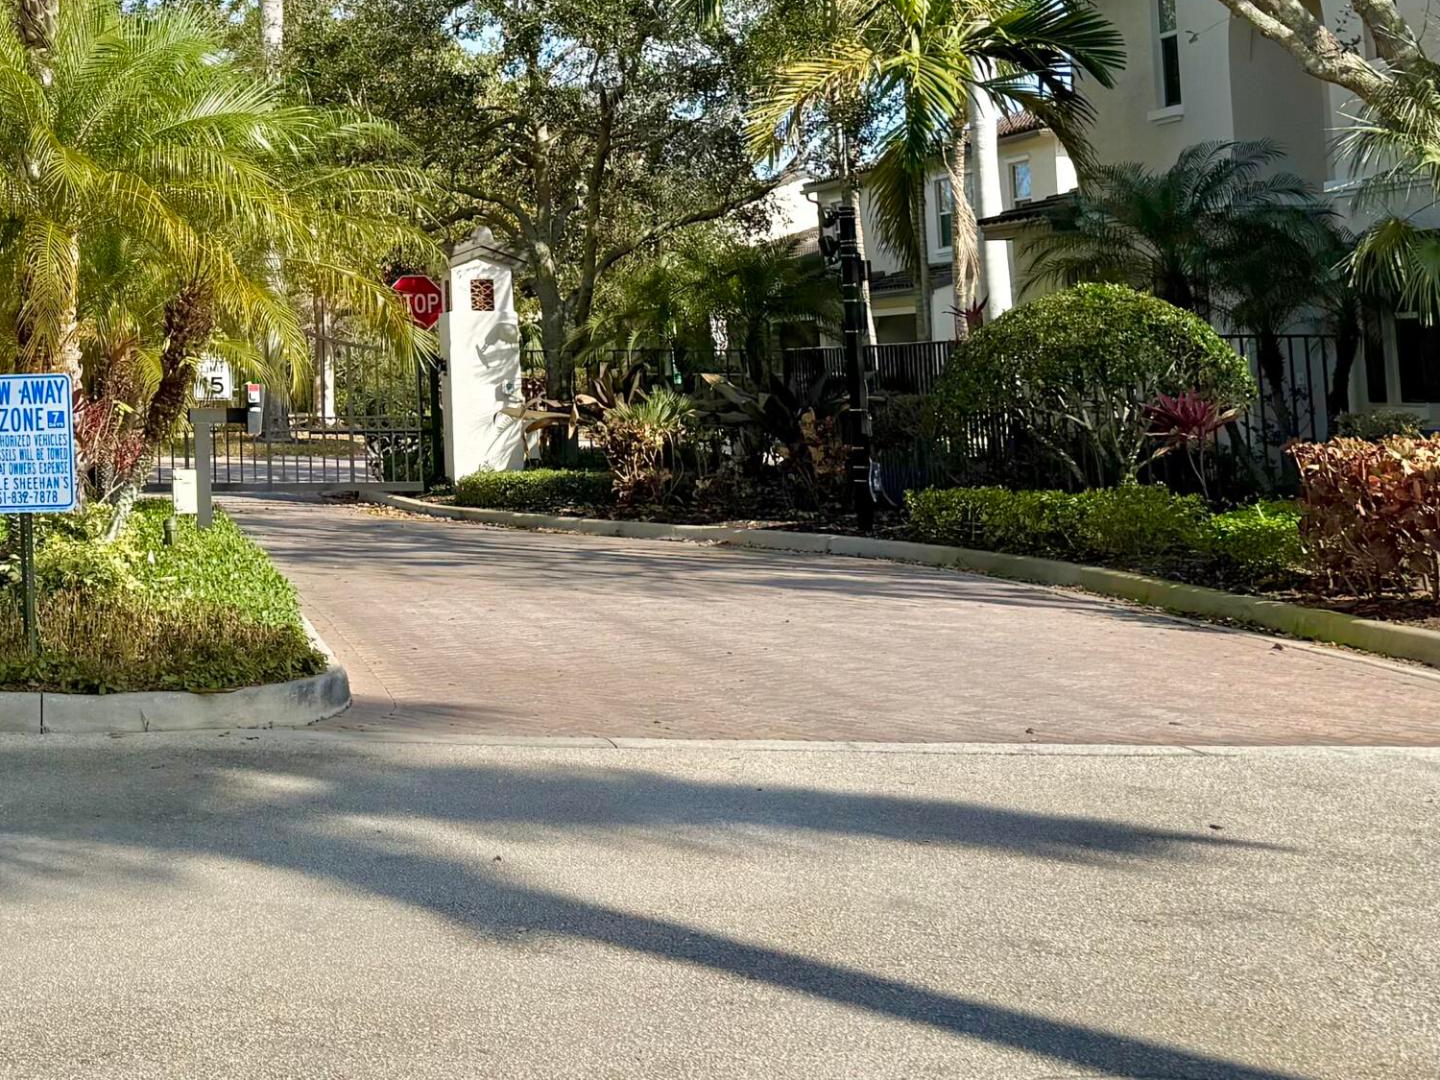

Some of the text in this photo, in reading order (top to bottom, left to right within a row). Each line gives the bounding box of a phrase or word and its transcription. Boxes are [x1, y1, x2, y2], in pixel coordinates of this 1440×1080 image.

[402, 293, 440, 314] TOP
[20, 379, 64, 404] AWAY
[0, 407, 45, 432] ZONE
[51, 411, 59, 423] 7
[34, 433, 68, 447] VEHICLES
[19, 447, 34, 461] WILL
[36, 447, 44, 460] BE
[47, 447, 68, 460] TOWED
[0, 462, 6, 475] AT
[9, 462, 37, 475] OWNERS
[39, 461, 68, 474] EXPENSE
[13, 476, 69, 490] SHEEHAN'S
